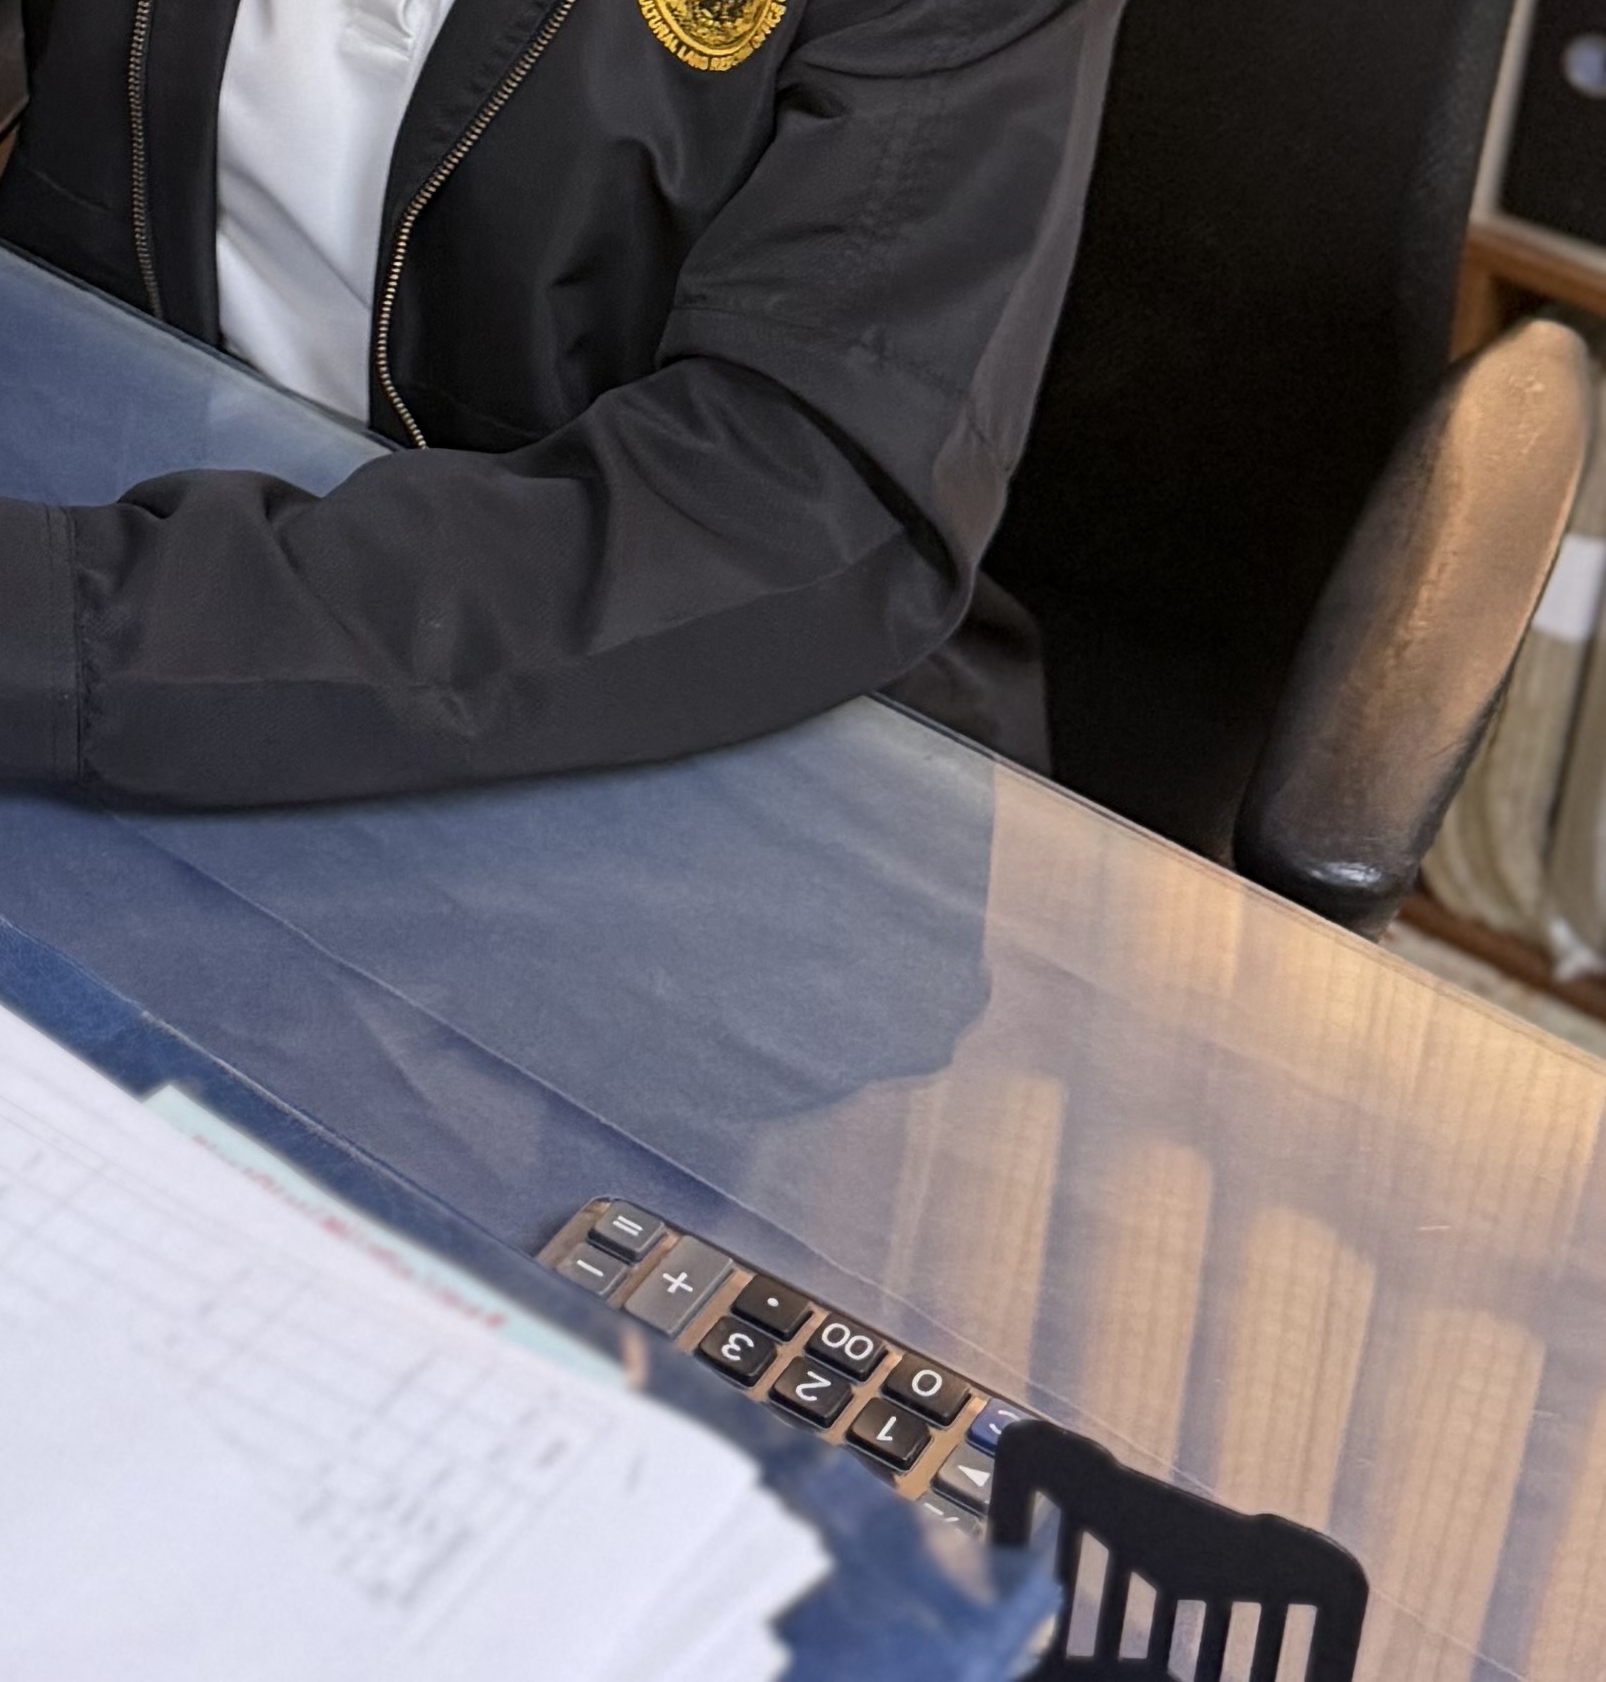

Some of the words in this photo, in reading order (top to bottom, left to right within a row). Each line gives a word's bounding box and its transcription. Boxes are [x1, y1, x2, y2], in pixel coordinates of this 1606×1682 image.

[720, 1332, 755, 1362] 3
[821, 1322, 874, 1361] 00
[795, 1370, 833, 1403] 2
[911, 1368, 944, 1398] 0
[875, 1415, 898, 1442] 1
